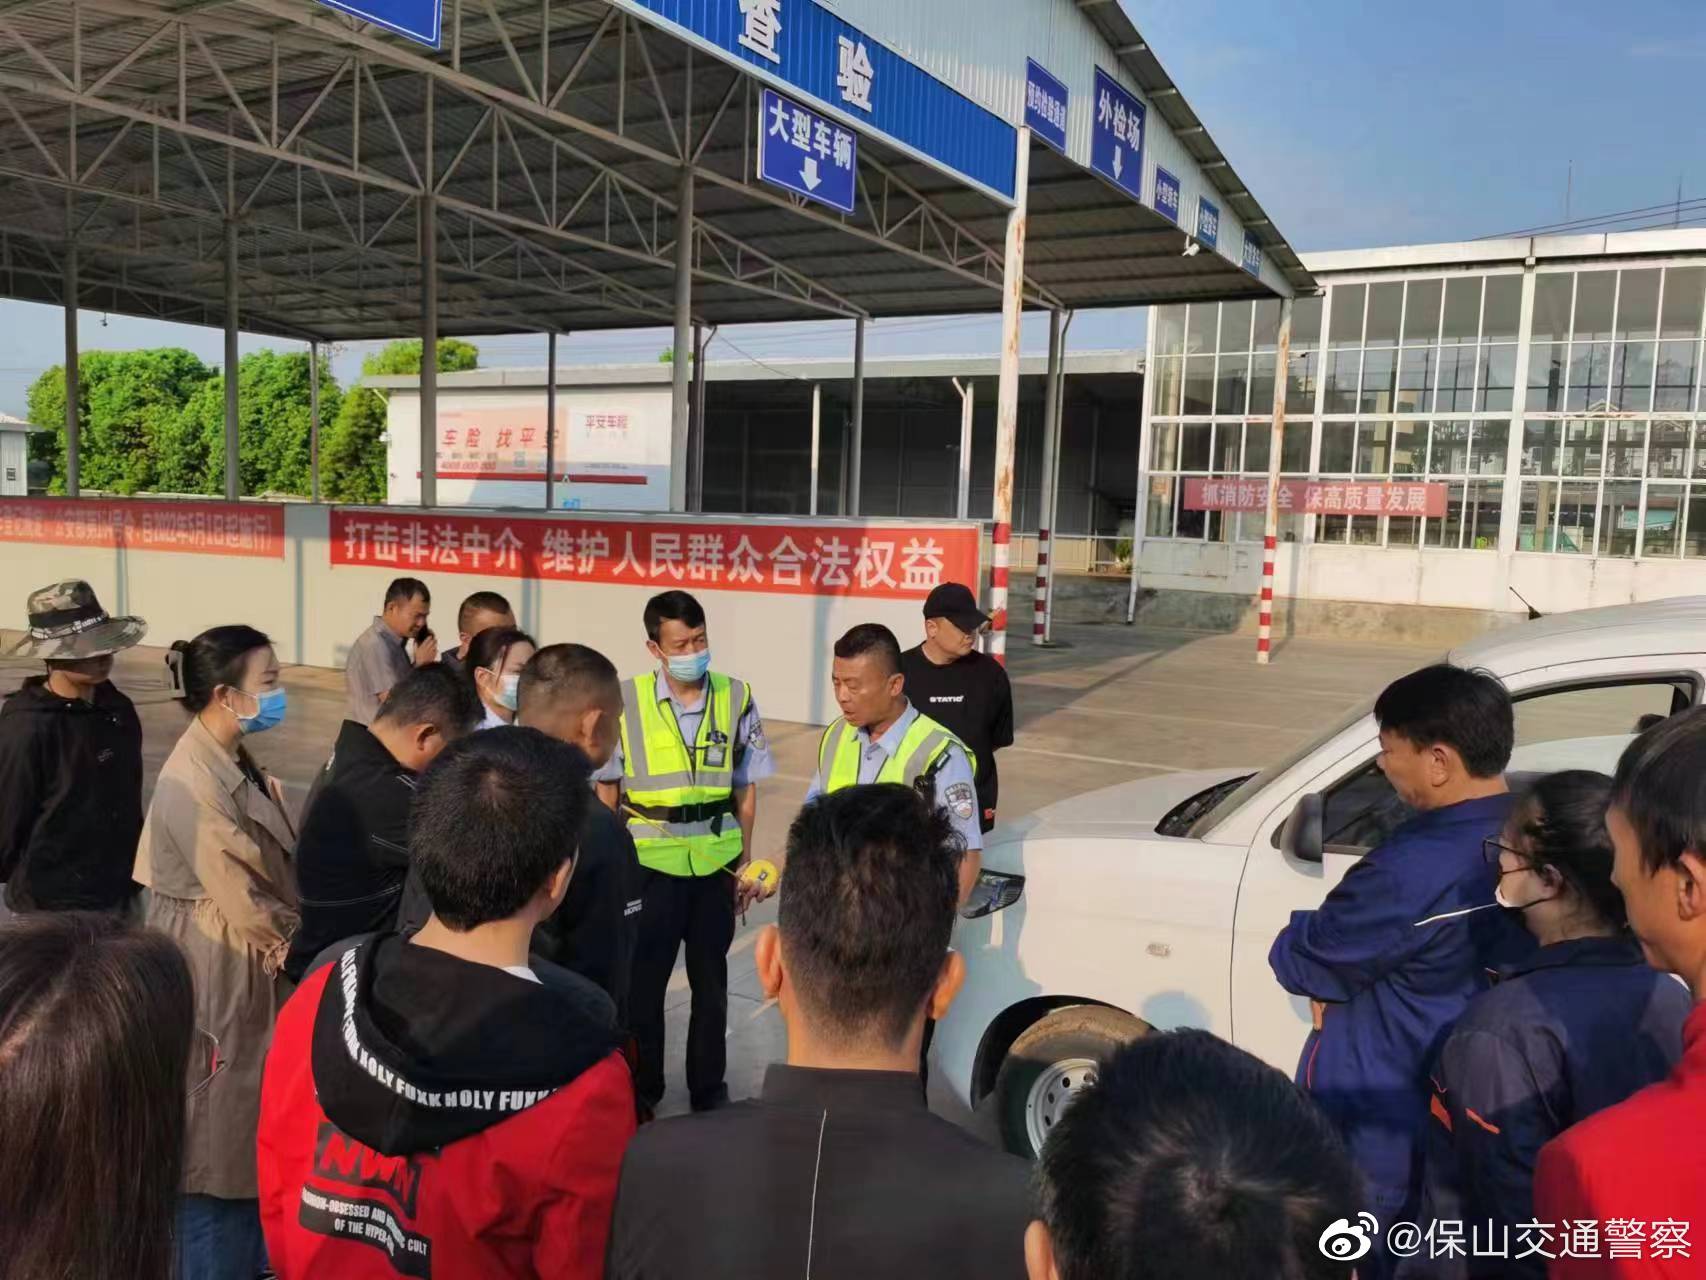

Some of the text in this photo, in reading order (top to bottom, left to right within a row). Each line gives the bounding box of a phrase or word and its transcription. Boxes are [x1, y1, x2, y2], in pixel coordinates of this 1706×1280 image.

[769, 99, 852, 171] 大型车辆
[1098, 88, 1141, 152] 外检场
[1304, 486, 1428, 511] 保高质量发展
[345, 520, 944, 590] 打击非法中介 维护人民群众合法权益
[360, 1048, 395, 1088] HOLY
[396, 1077, 441, 1107] FUXK
[445, 1089, 494, 1110] HOLY
[334, 1218, 345, 1232] OF
[348, 1221, 364, 1235] THE
[371, 1207, 386, 1223] AND
[407, 1238, 427, 1256] CULT
